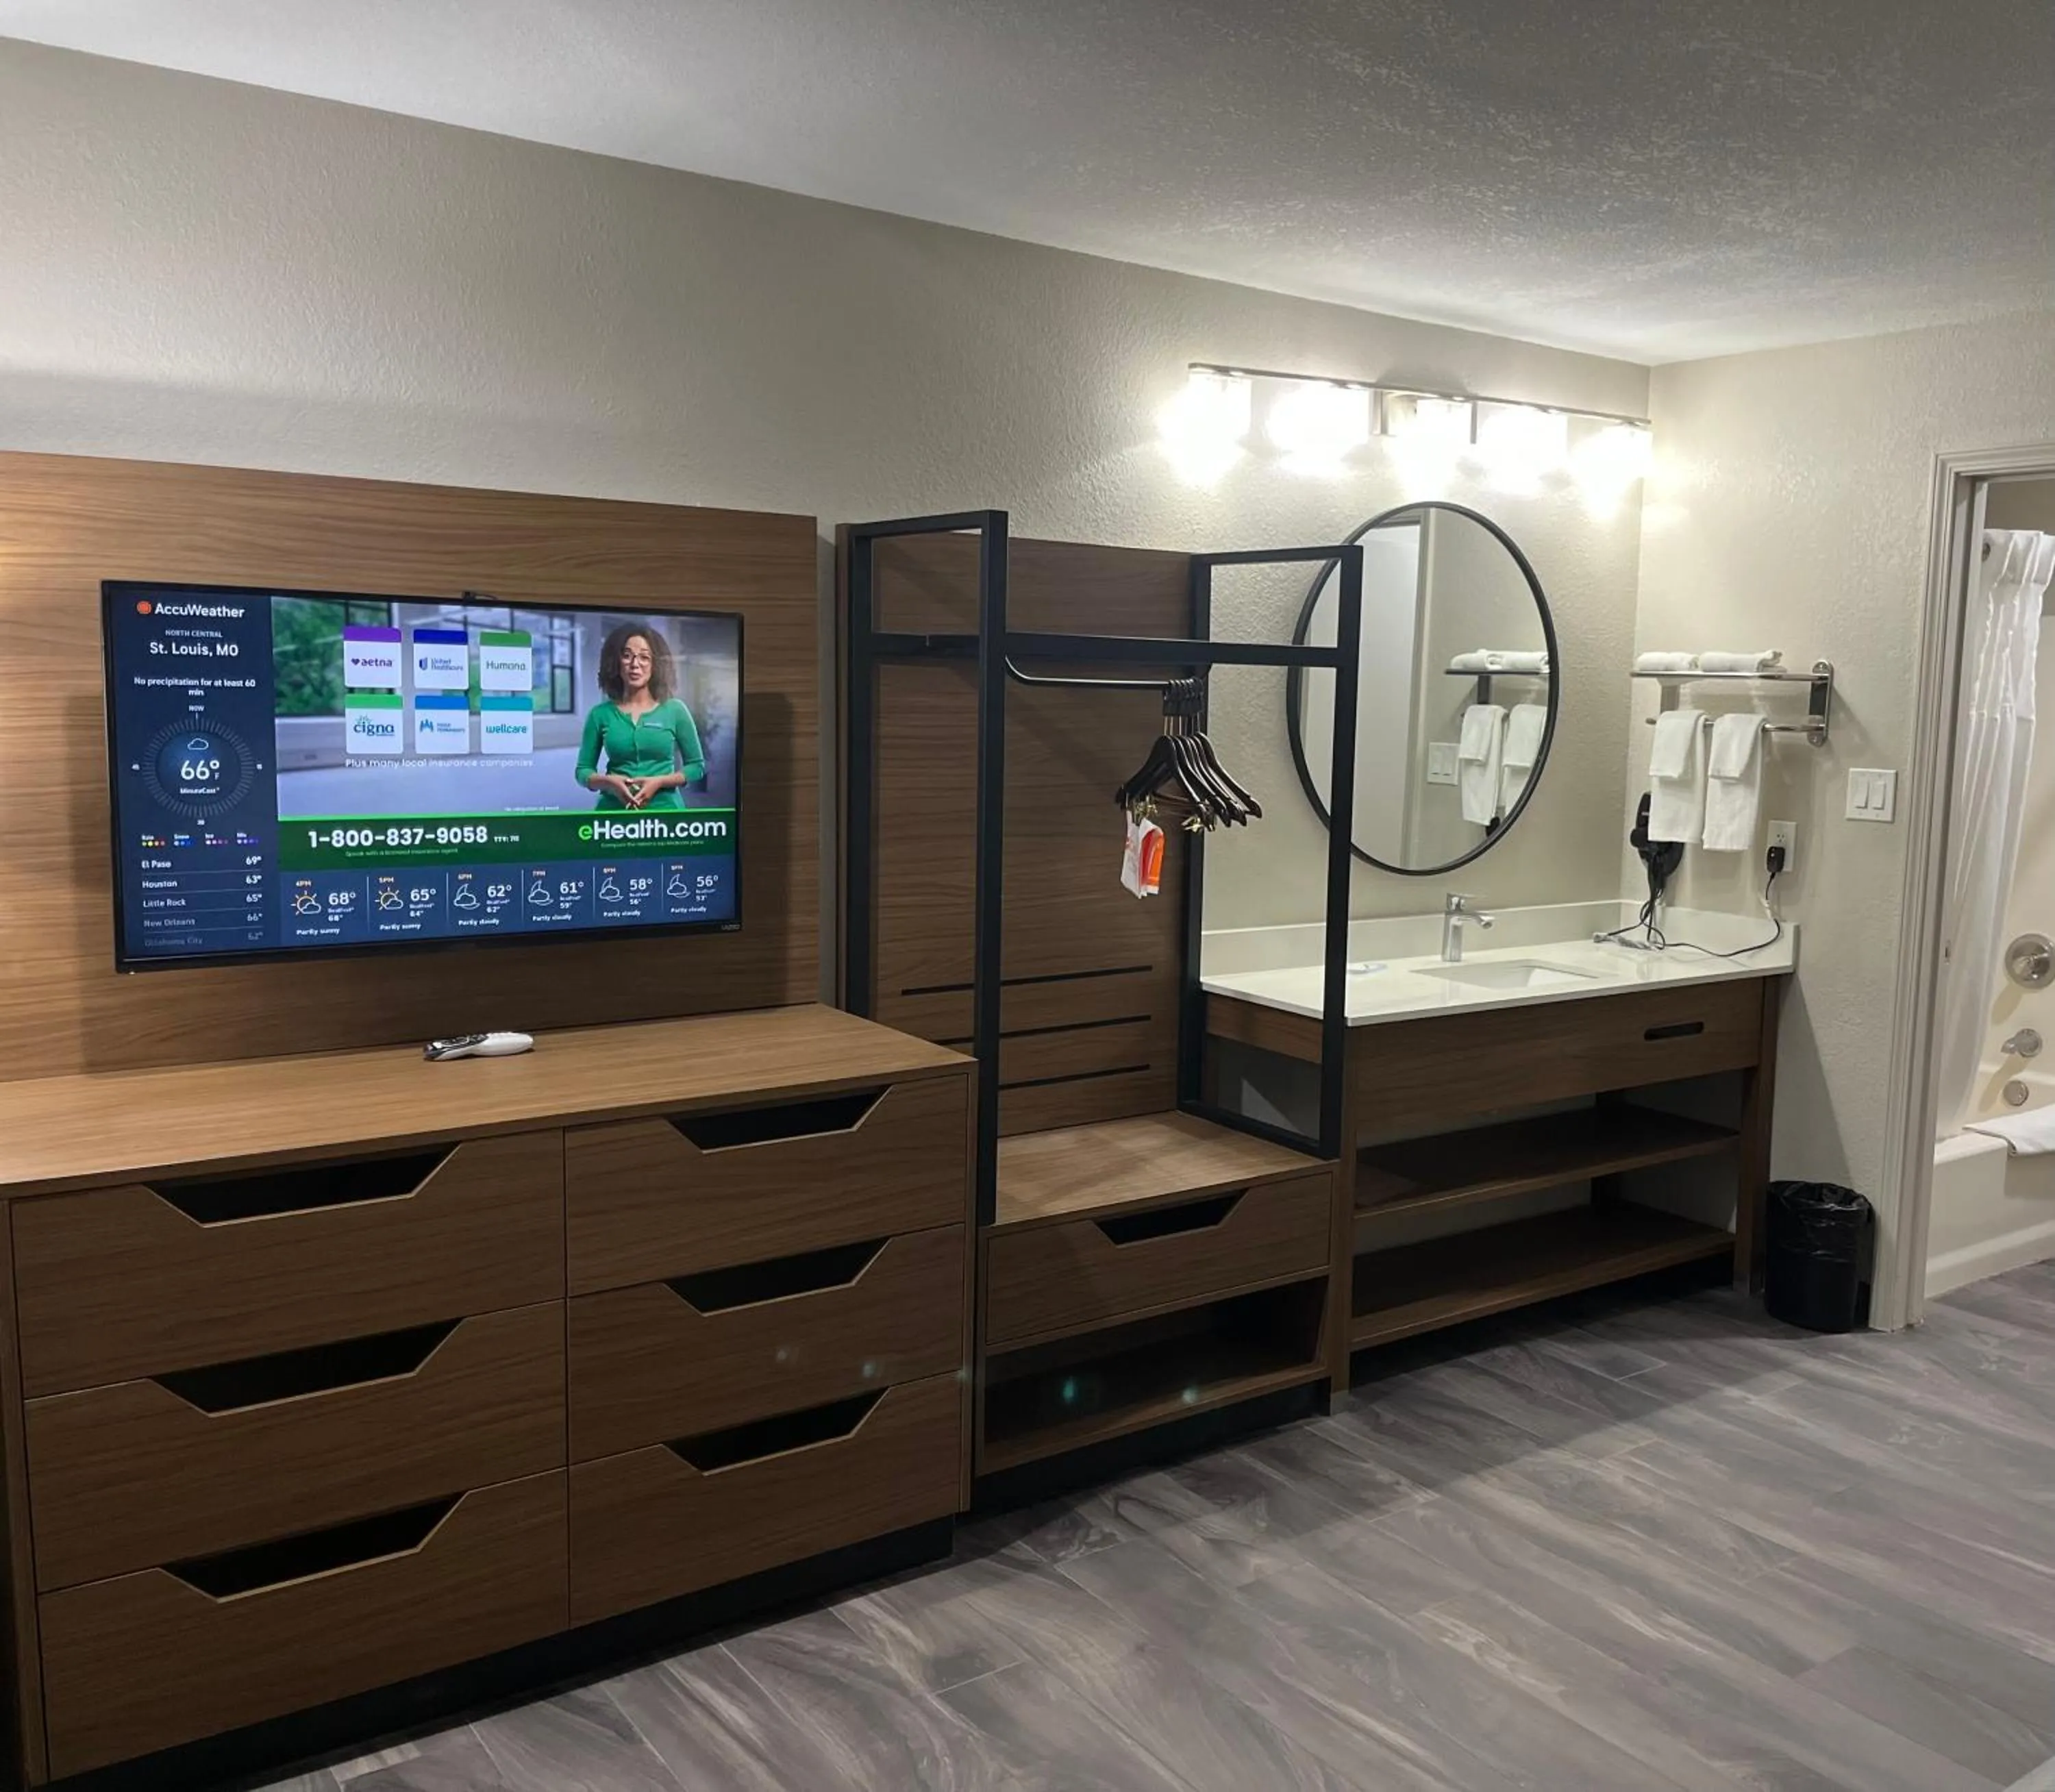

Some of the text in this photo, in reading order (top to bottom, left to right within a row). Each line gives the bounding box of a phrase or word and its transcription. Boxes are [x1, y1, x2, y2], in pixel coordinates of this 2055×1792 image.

[154, 602, 245, 617] AccuWeather
[165, 629, 224, 638] NORTH CENTRAL
[149, 641, 239, 657] St. Louis, MO
[361, 657, 393, 667] aetna
[486, 660, 526, 671] Humana
[134, 677, 146, 685] No
[147, 677, 199, 687] precipitation
[201, 677, 212, 686] for
[223, 678, 243, 687] least
[245, 679, 256, 687] 60
[353, 719, 395, 736] cigna
[486, 723, 527, 734] wellcare
[345, 758, 366, 767] Plus
[369, 759, 400, 769] many
[402, 758, 427, 767] local
[428, 759, 477, 767] insurance
[180, 759, 221, 780] 66°
[577, 819, 727, 841] eHealth.com
[308, 825, 488, 849] 1-800-837-9058
[142, 860, 172, 869] El Paso
[245, 856, 262, 866] 69°
[142, 880, 178, 888] Houston
[245, 875, 262, 884] 63°
[629, 878, 653, 891] 58°
[696, 874, 719, 888] 56°
[487, 884, 512, 897] 62°
[559, 881, 584, 894] 61°
[246, 893, 262, 903] 65°
[328, 891, 356, 906] 68°
[410, 888, 437, 901] 65°
[142, 898, 186, 908] Little Rock
[143, 918, 196, 928] New Orleans
[458, 919, 478, 927] Partly
[296, 928, 319, 936] Partly
